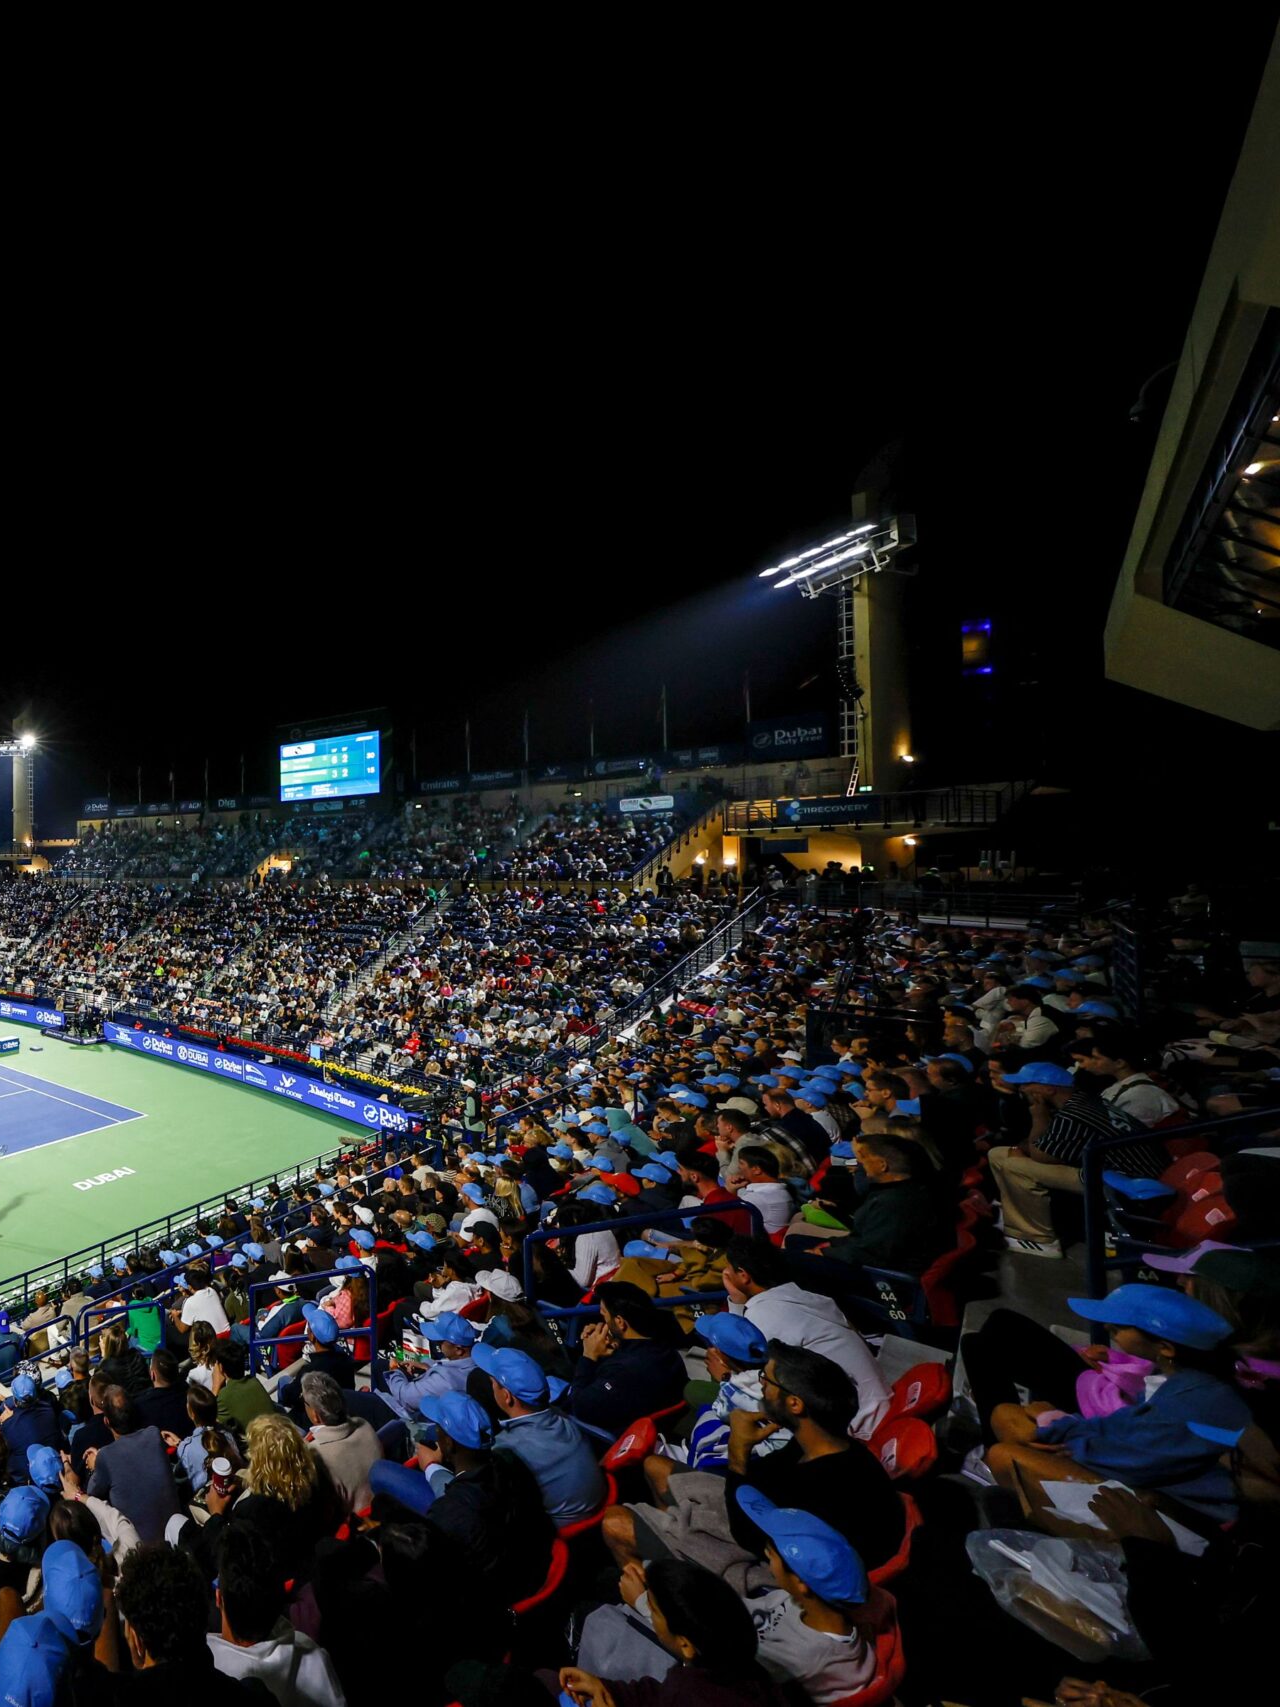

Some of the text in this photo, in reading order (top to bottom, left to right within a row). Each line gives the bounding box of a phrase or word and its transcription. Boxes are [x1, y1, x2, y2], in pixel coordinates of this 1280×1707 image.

[774, 727, 823, 740] Dubai
[420, 779, 460, 791] Emirates
[43, 1011, 62, 1022] Dubai
[151, 1037, 173, 1051] Dubai
[188, 1051, 209, 1064] DUBAI
[222, 1058, 242, 1071] Dubai
[333, 1092, 356, 1108] Times
[379, 1107, 408, 1125] Dub
[72, 1166, 137, 1191] DUBAI
[880, 1292, 897, 1302] 44
[889, 1310, 906, 1320] 60
